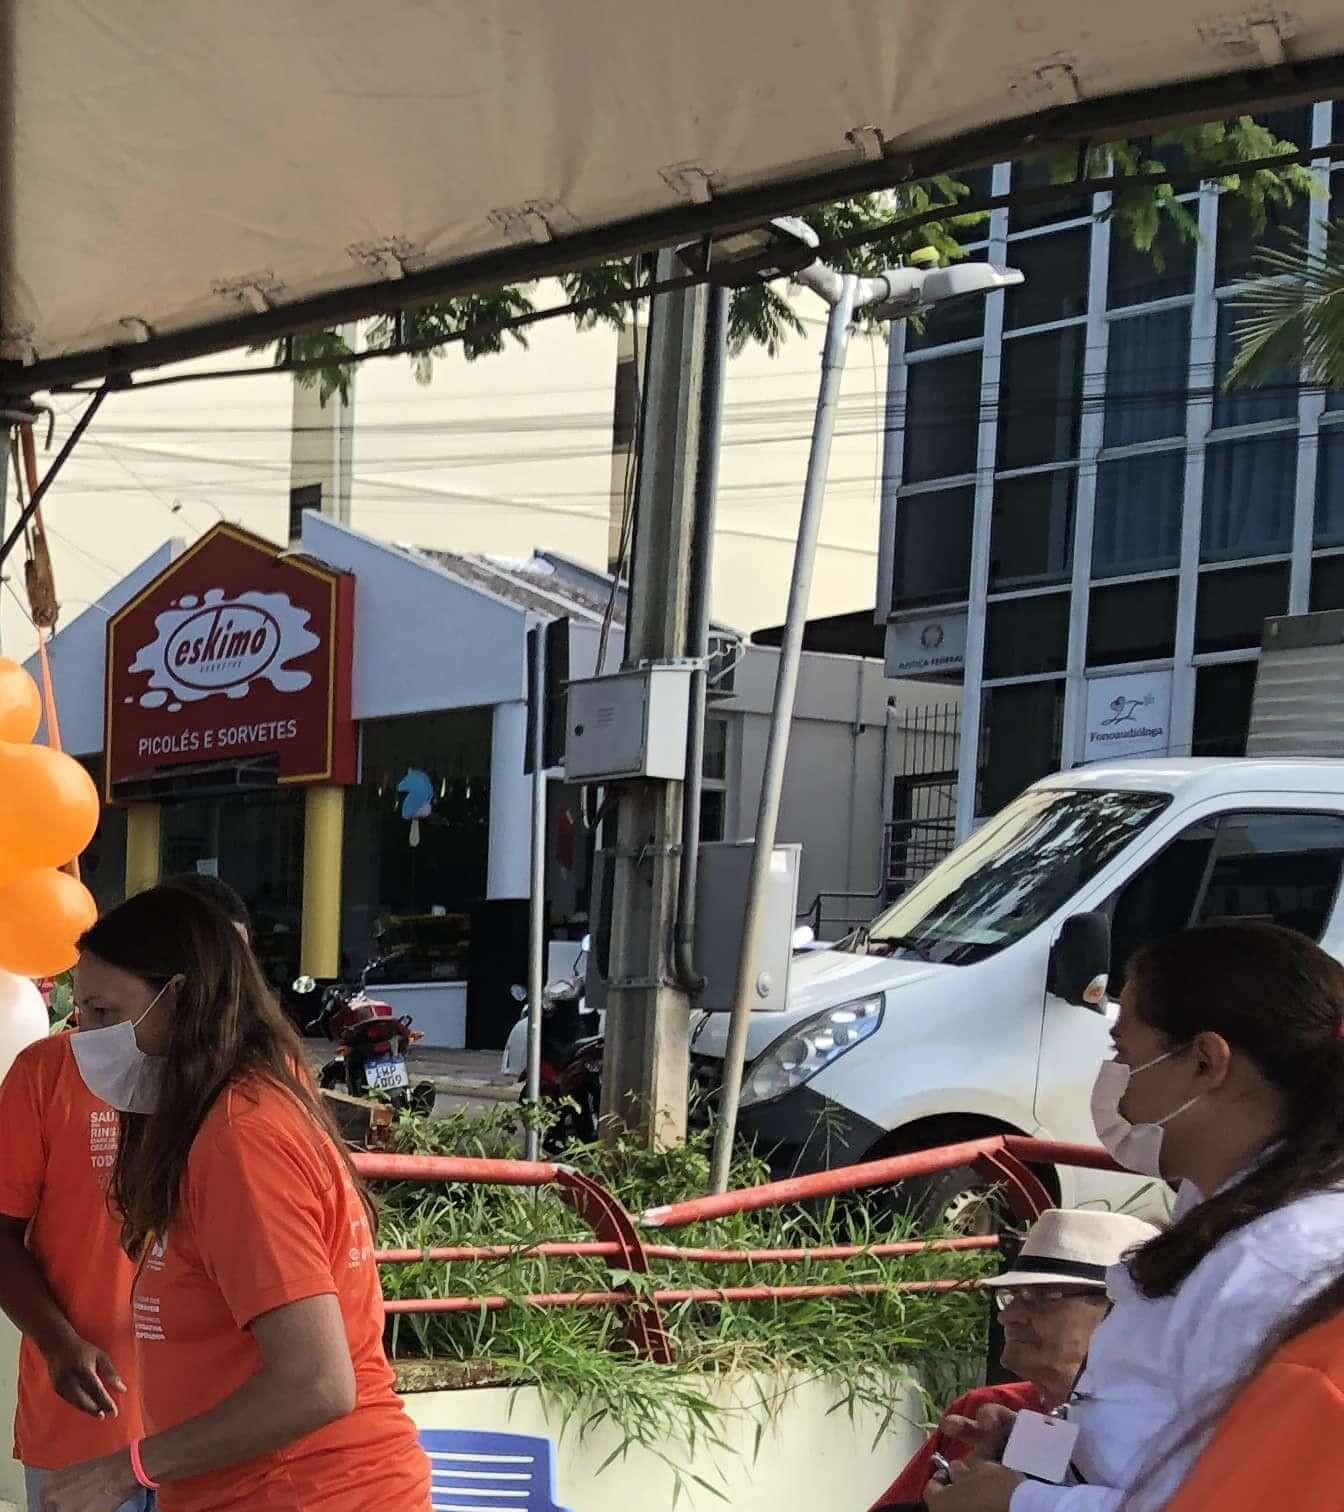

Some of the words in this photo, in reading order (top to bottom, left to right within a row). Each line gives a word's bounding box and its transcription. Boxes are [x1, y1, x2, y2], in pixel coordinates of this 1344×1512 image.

[175, 606, 270, 668] eskimó
[138, 728, 199, 756] PICOLÉS
[204, 730, 213, 748] E
[218, 719, 297, 747] SORVETES
[90, 1108, 120, 1123] SAÚ
[90, 1155, 115, 1168] TOD
